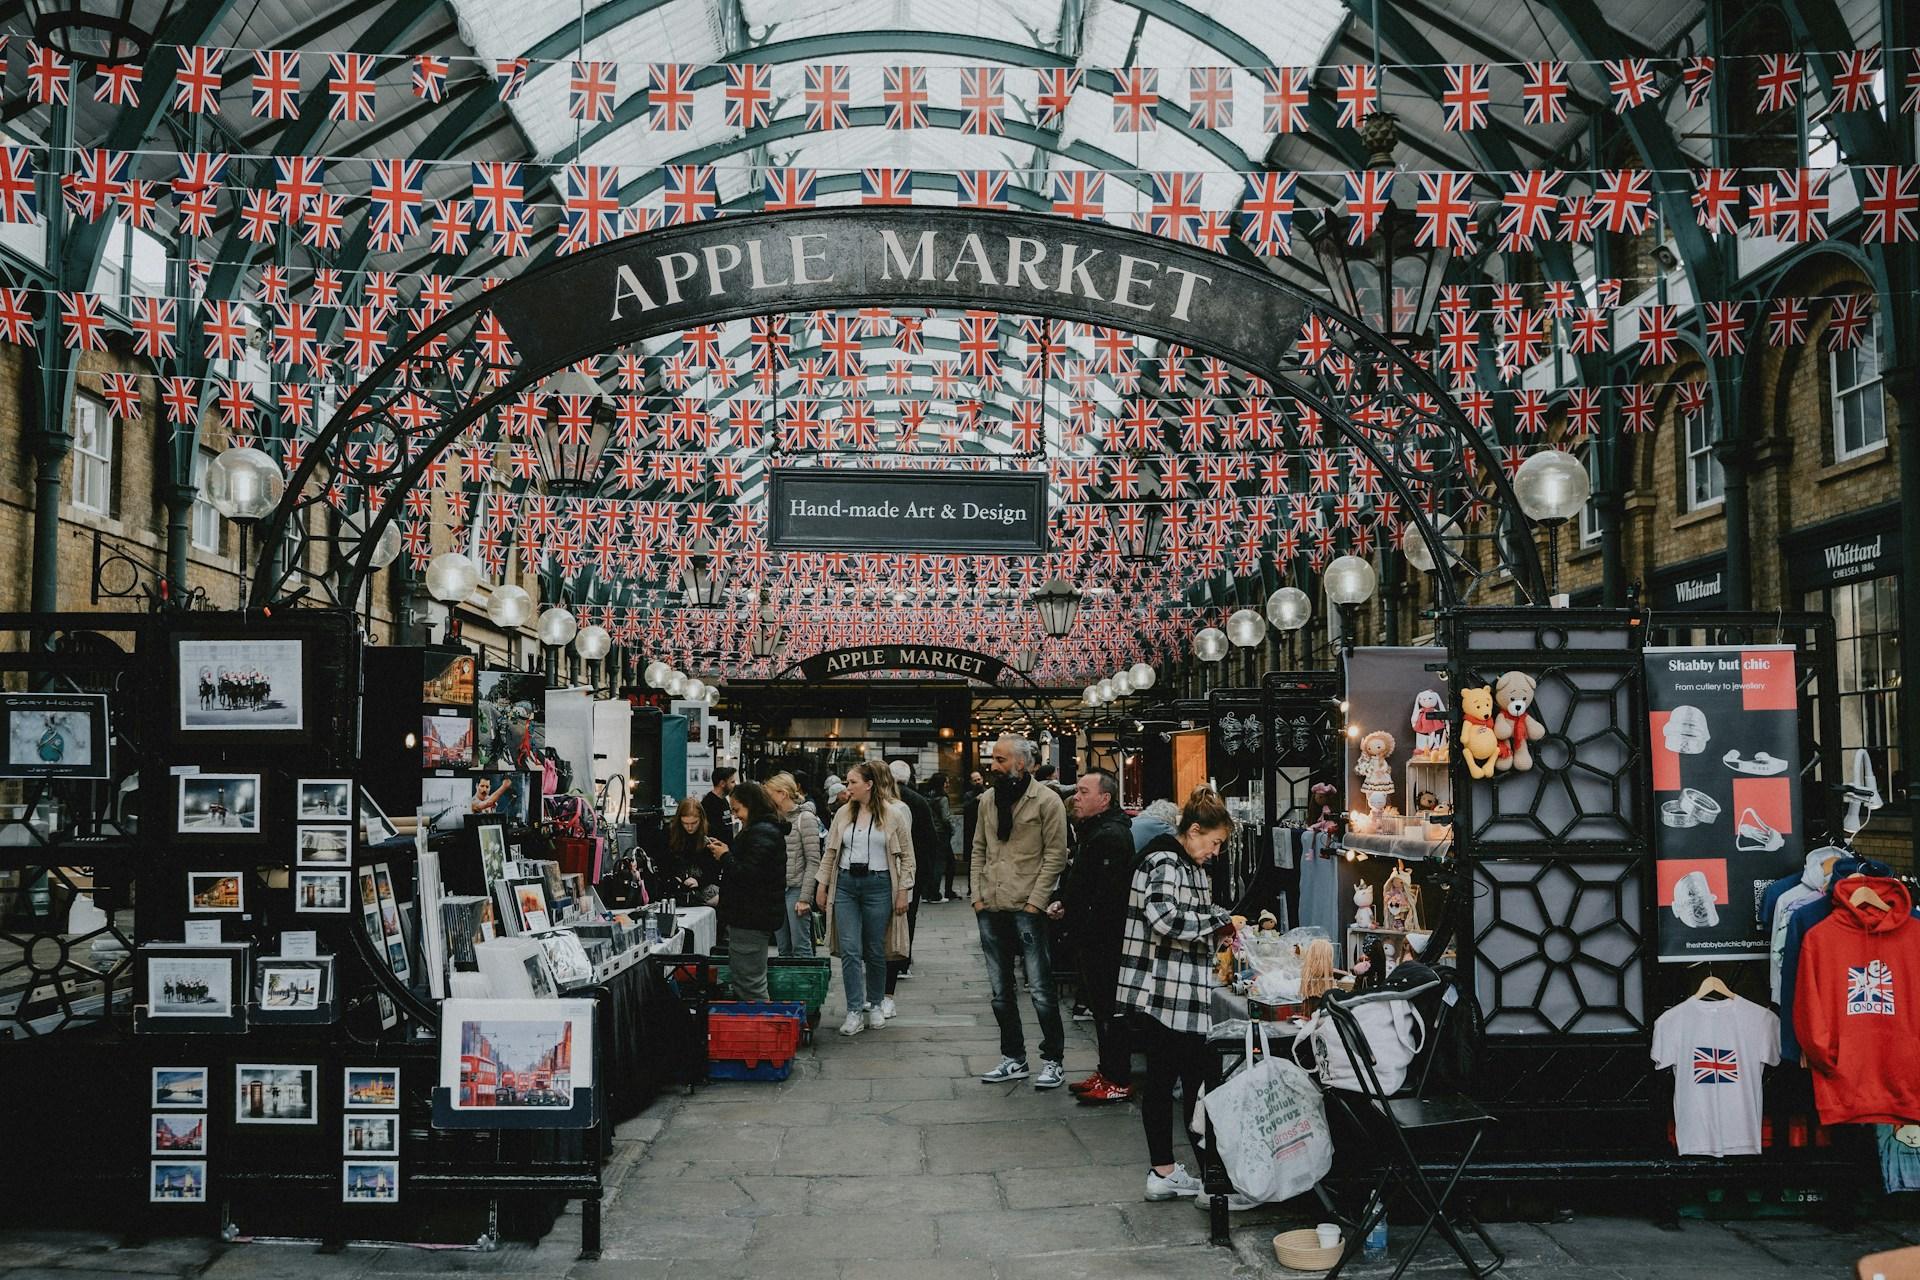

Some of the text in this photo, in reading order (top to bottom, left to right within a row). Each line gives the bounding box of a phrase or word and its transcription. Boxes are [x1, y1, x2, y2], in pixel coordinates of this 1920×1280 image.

[608, 229, 1213, 324] APPLE MARKET
[789, 499, 1028, 525] Hand-made Art & Design
[1824, 534, 1882, 569] Whittard
[1832, 562, 1876, 580] CHELSEA 1886
[1675, 572, 1722, 603] Whittard
[826, 649, 987, 675] APPLE MARKET
[1668, 658, 1770, 673] Shabby but chic
[1675, 681, 1765, 692] From cutlery to jewellery
[1849, 1002, 1893, 1013] LONDON
